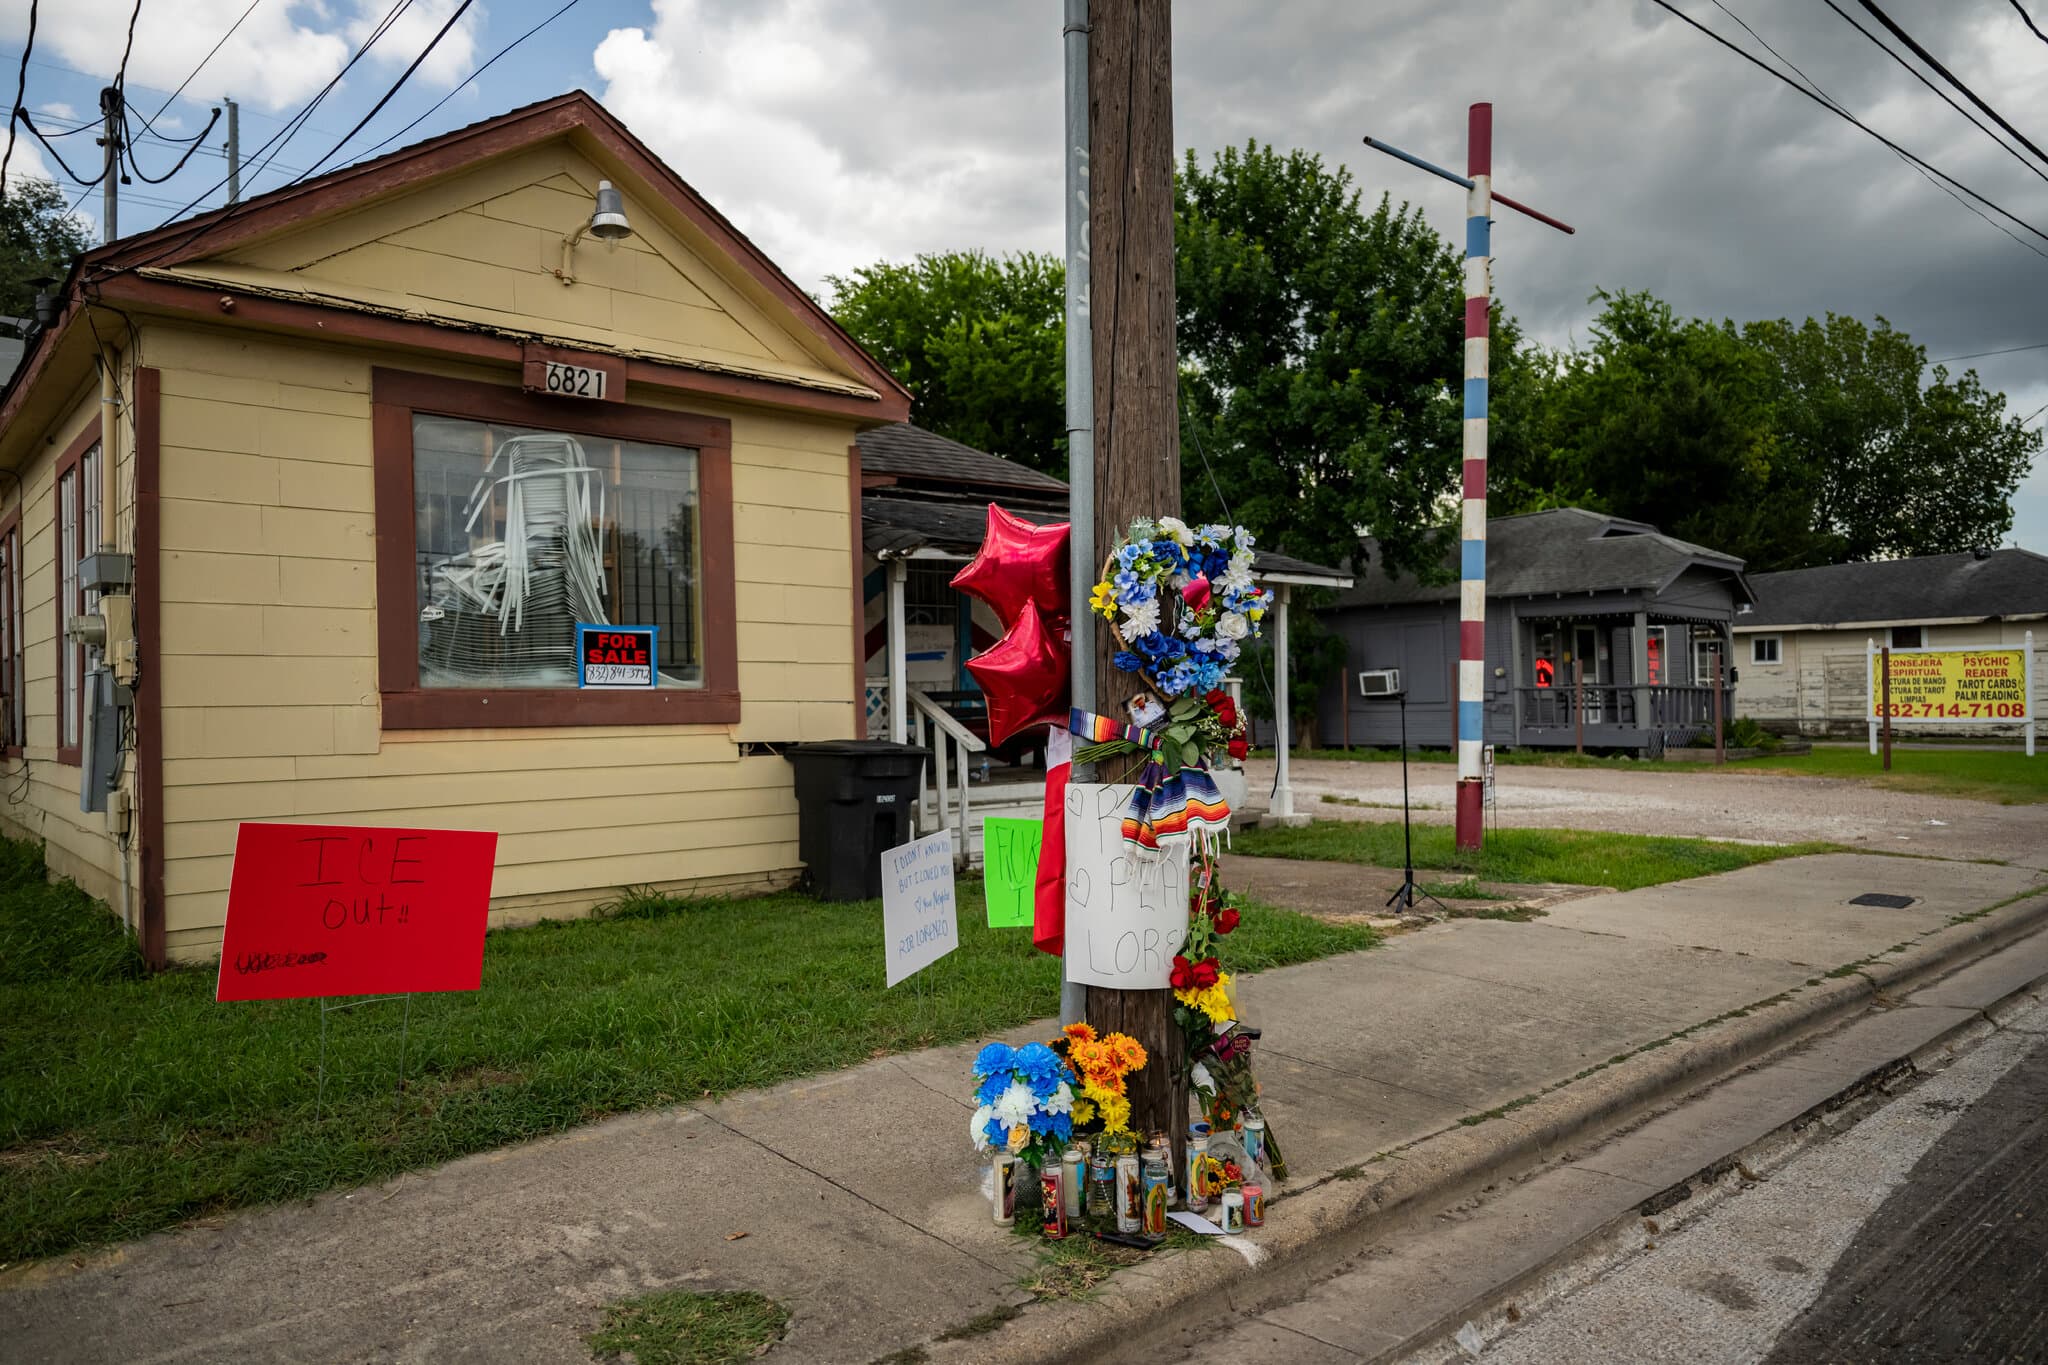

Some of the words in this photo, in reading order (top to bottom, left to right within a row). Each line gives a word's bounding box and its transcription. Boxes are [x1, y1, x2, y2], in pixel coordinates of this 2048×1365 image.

[548, 364, 602, 398] 6821
[598, 633, 637, 649] FOR
[588, 649, 647, 664] SALE
[1963, 656, 2010, 666] PSYCHIC
[1965, 668, 2008, 677] READER
[1889, 677, 1911, 686] CTURA
[1912, 677, 1921, 685] DE
[1923, 677, 1946, 685] MANOS
[1957, 679, 1985, 689] TAROT
[1988, 679, 2017, 689] CARDS
[1889, 687, 1912, 695] CTURA
[1913, 686, 1922, 694] DE
[1924, 686, 1945, 694] TAROT
[1955, 691, 1978, 700] PALM
[1980, 690, 2019, 700] READING
[1900, 695, 1926, 703] LIMPIAS
[1875, 703, 2025, 718] 832-714-7108
[297, 836, 428, 887] ICE
[898, 875, 912, 894] BUT
